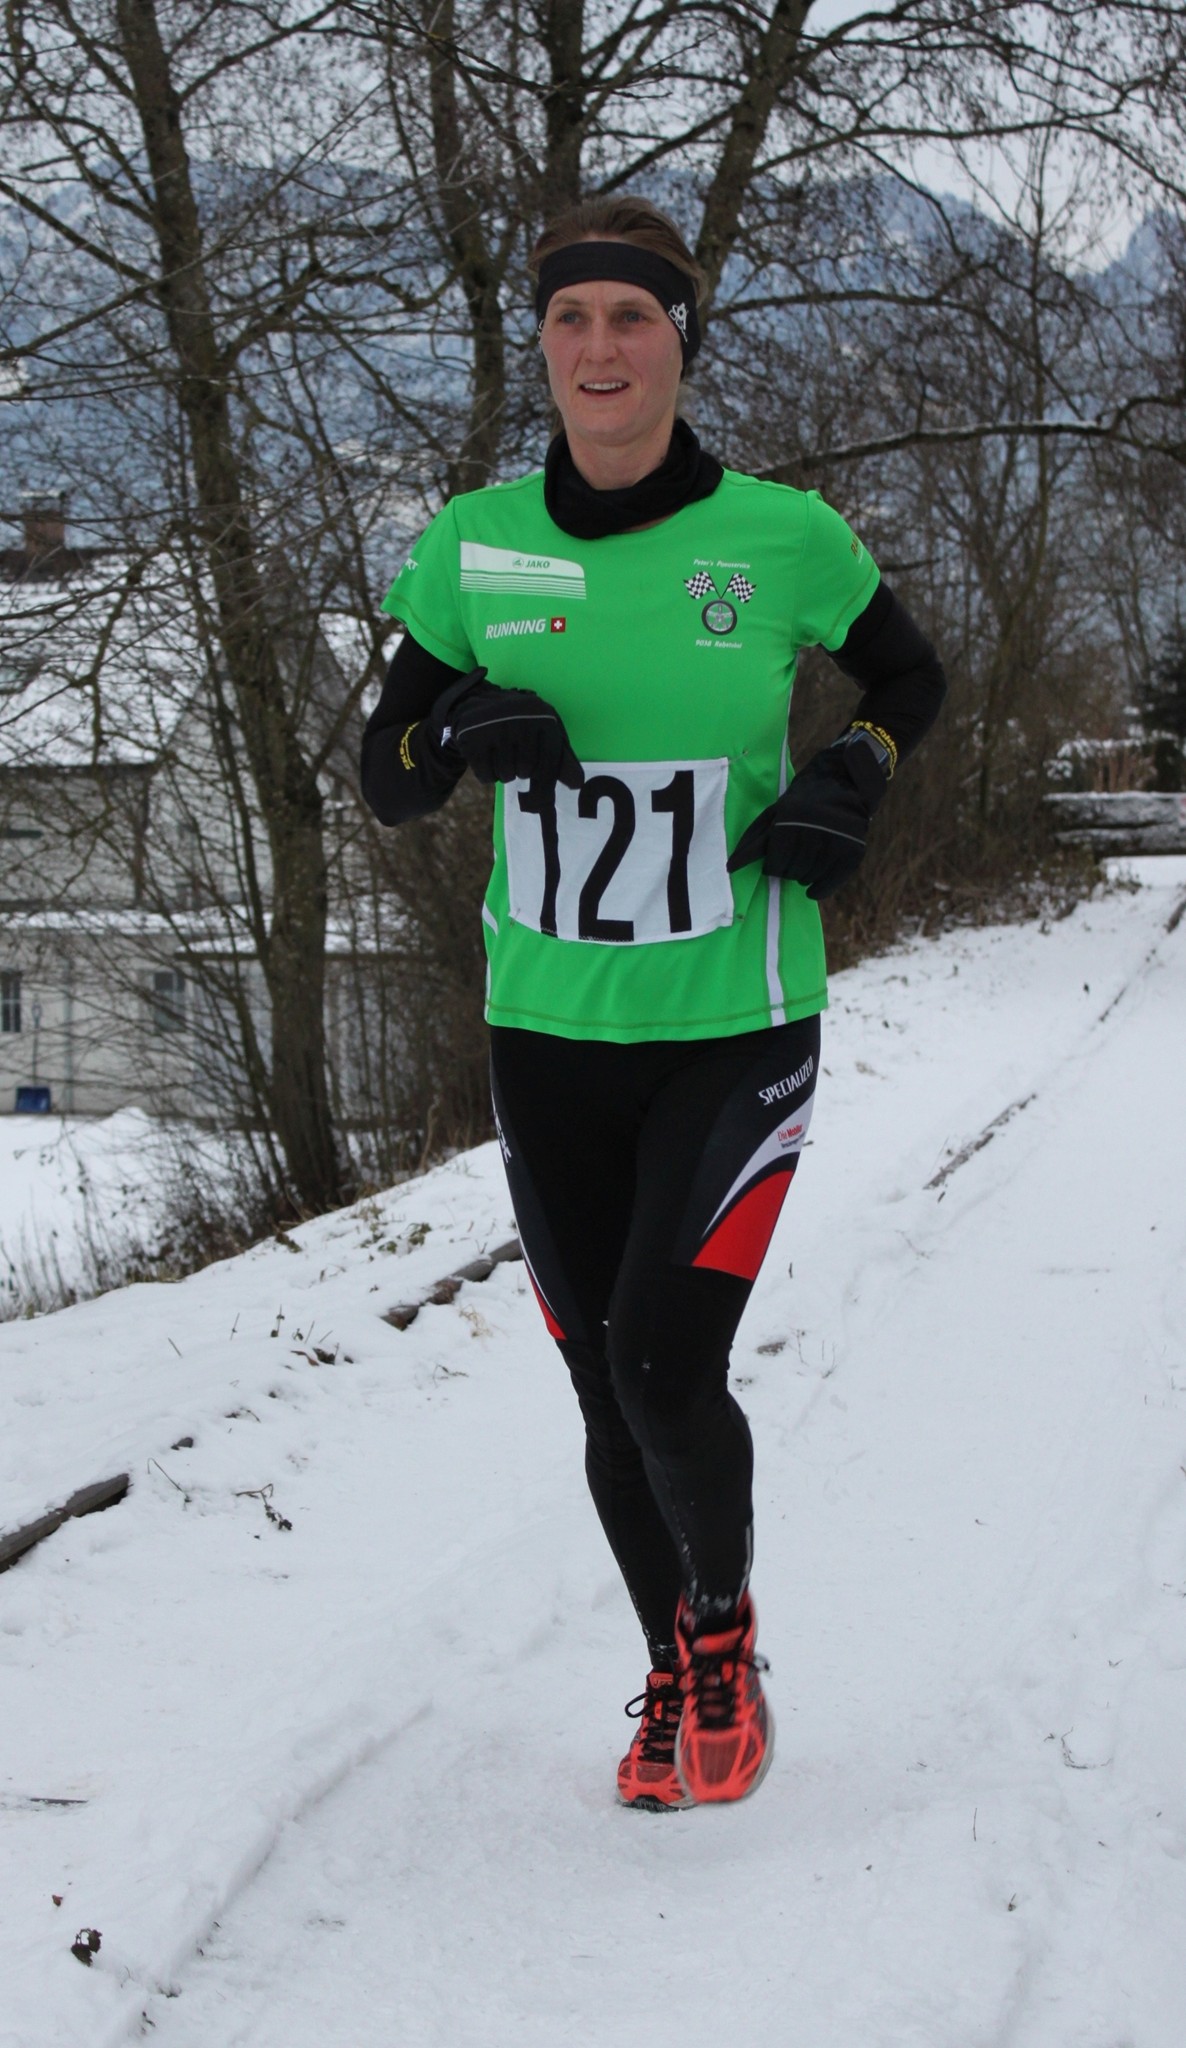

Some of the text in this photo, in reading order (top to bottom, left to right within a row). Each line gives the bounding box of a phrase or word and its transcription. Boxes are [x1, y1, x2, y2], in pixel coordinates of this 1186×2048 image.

[525, 559, 550, 569] JAKO
[485, 618, 546, 640] RUNNING
[517, 770, 695, 942] 121
[758, 1055, 814, 1106] SPECIALIZED
